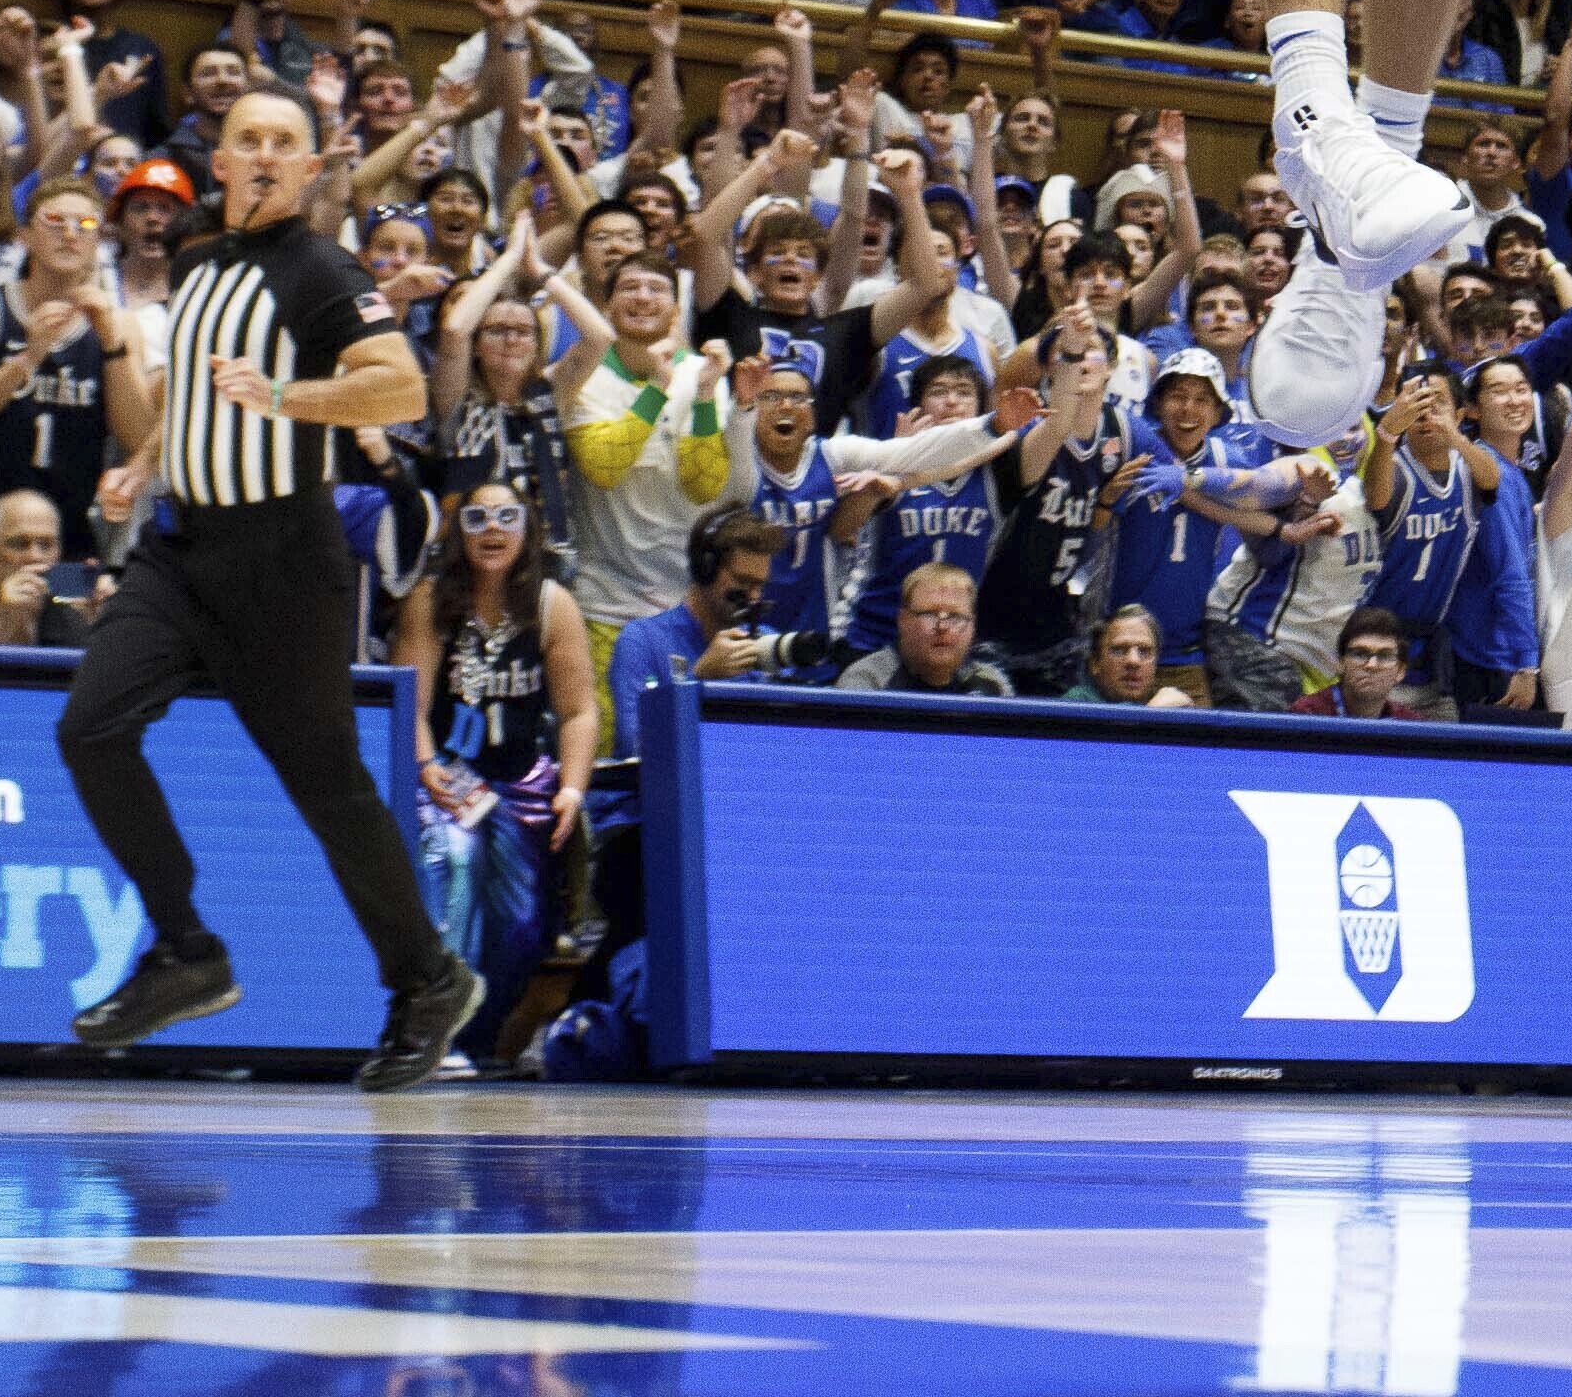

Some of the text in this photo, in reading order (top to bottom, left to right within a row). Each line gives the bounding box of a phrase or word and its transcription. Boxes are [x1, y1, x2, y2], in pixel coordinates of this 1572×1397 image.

[32, 412, 53, 468] 1
[899, 507, 988, 536] DUKE
[1169, 512, 1188, 563] 1
[791, 529, 809, 568] 1
[1048, 538, 1084, 586] 5
[1412, 541, 1434, 582] 1
